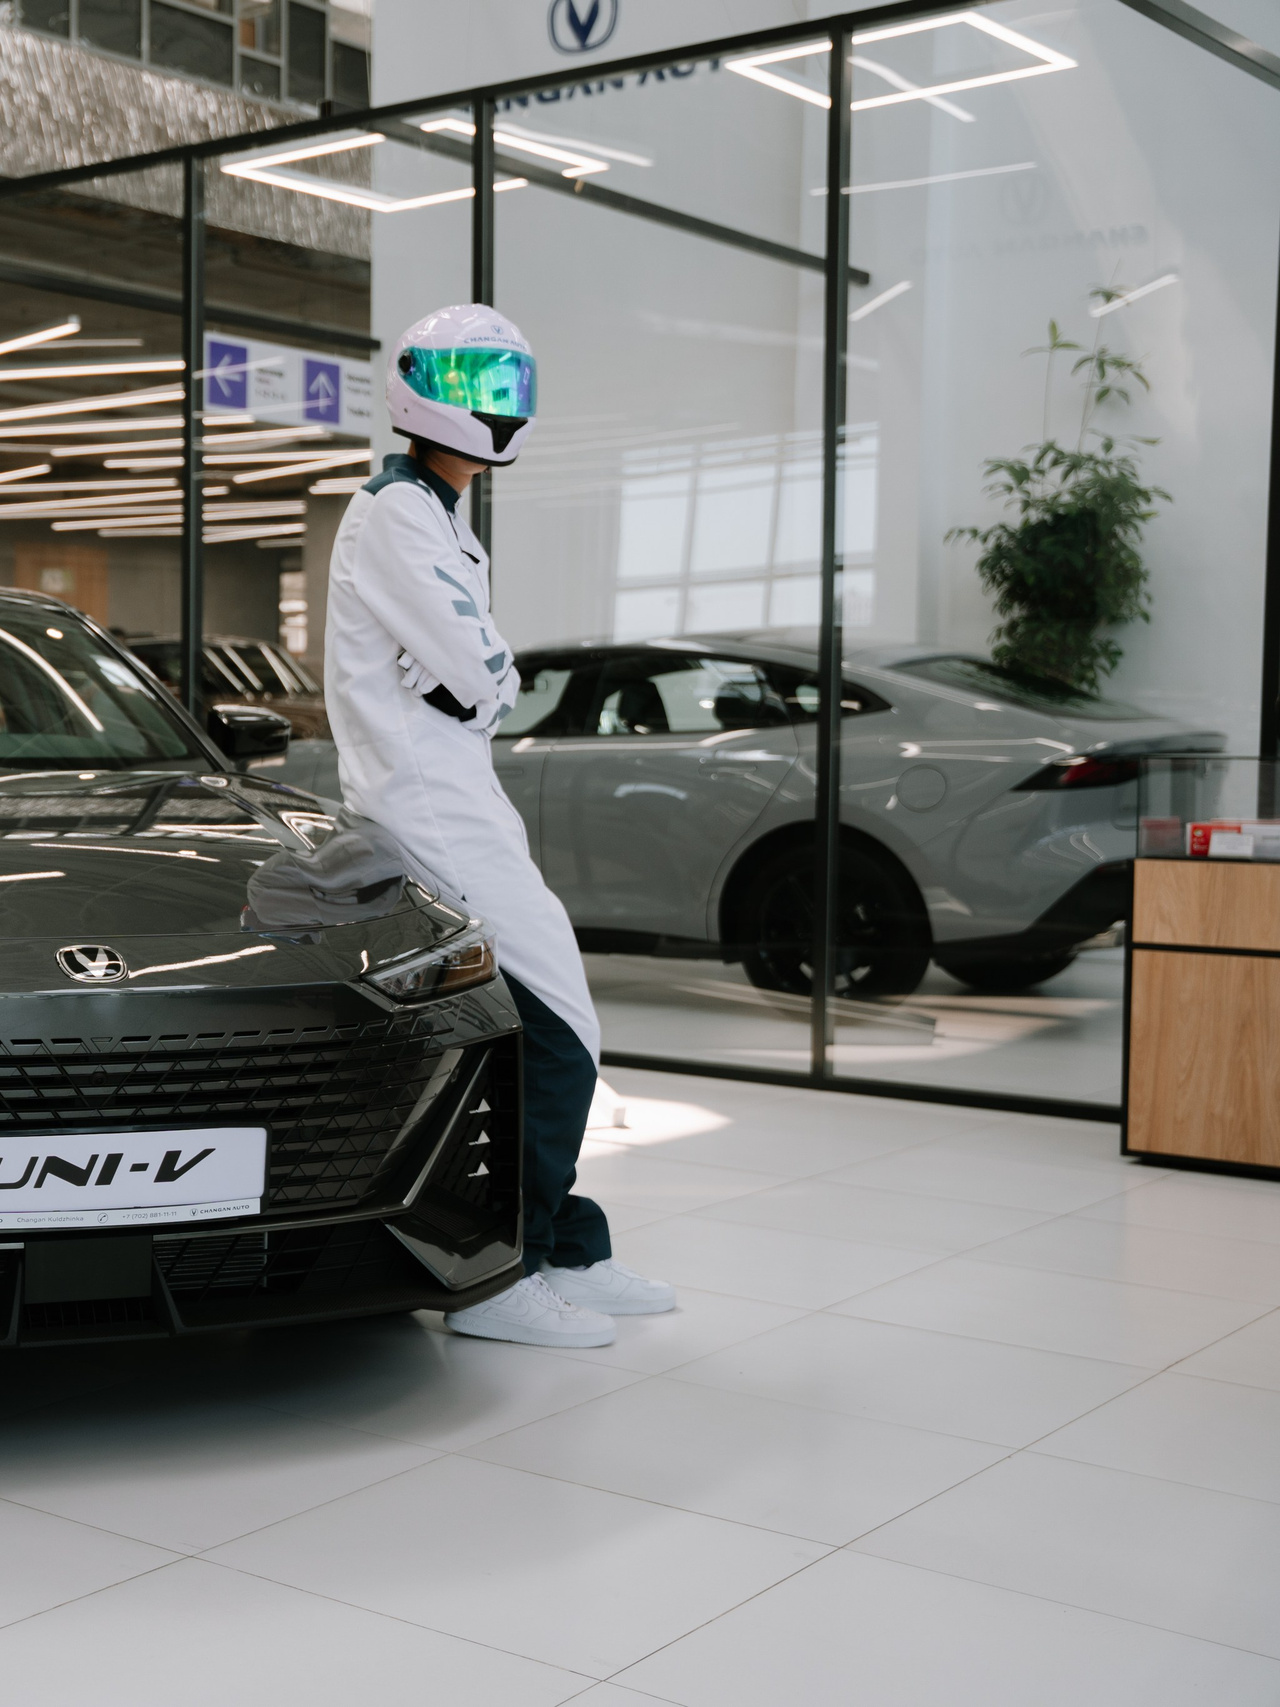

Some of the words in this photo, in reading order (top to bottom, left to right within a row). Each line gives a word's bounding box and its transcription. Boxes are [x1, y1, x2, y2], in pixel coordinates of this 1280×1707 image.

[463, 336, 509, 344] CHANGAN
[200, 1206, 231, 1214] CHANGAN
[16, 1216, 46, 1224] Changan
[131, 1212, 148, 1220] (702)
